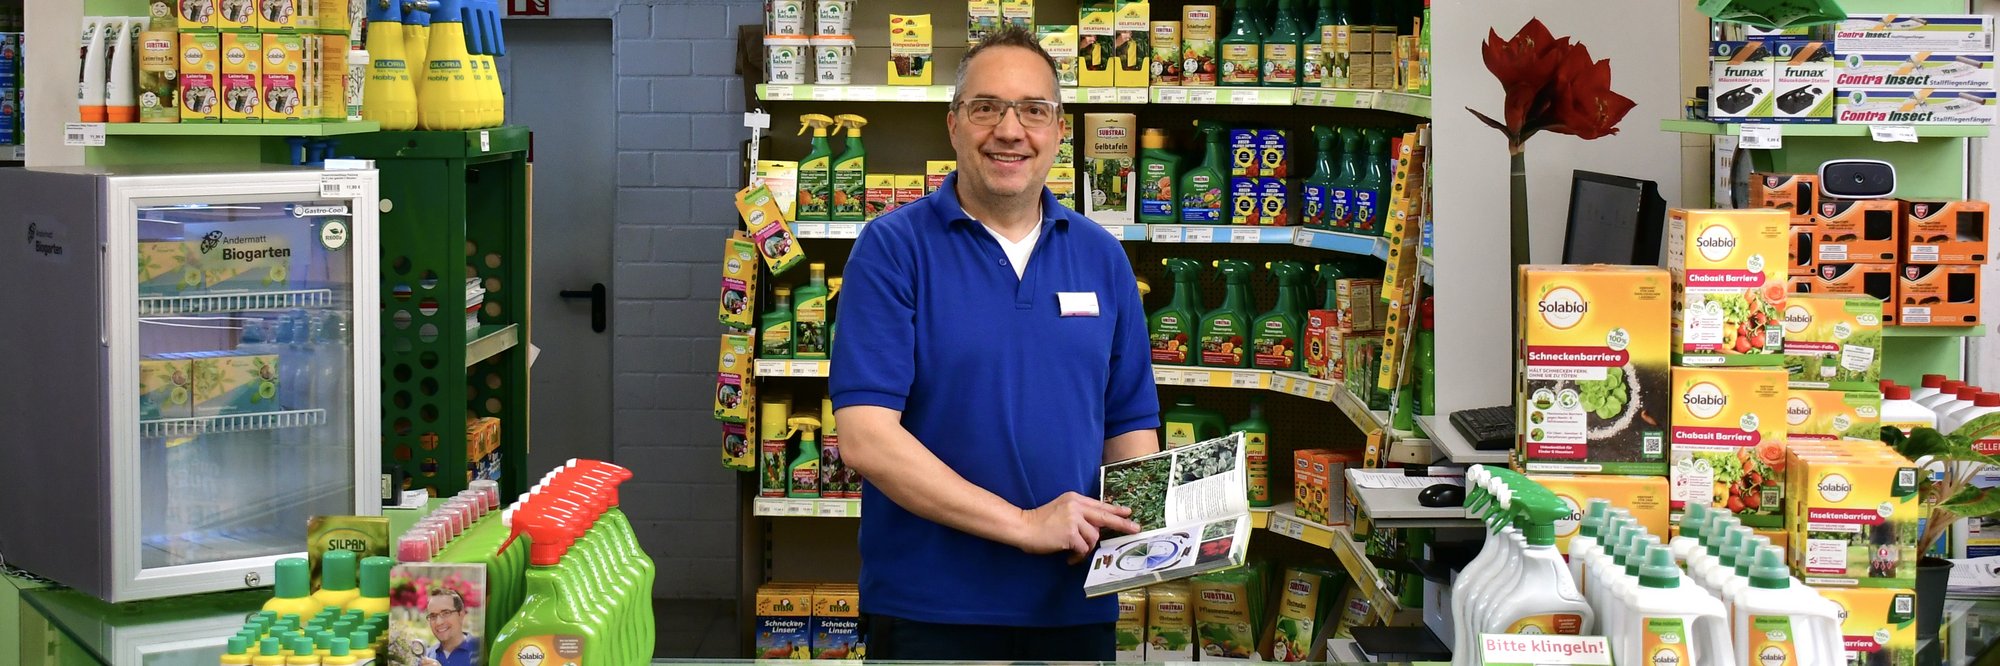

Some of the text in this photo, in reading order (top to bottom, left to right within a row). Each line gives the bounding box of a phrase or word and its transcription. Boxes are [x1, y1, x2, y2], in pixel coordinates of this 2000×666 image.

[1725, 67, 1764, 77] frunax
[1785, 67, 1824, 77] frunax
[1836, 74, 1883, 85] Contra
[1885, 74, 1930, 85] Insect
[1840, 110, 1887, 121] Contra
[1888, 111, 1934, 122] Insect
[1095, 142, 1128, 151] Gelbtafeln
[223, 236, 267, 245] Andermatt
[1696, 236, 1736, 248] Solabiol
[222, 247, 291, 262] Biogarten
[1689, 274, 1758, 282] Chabasit Barriere
[1538, 300, 1588, 313] Solabiol
[1785, 314, 1812, 323] olabiol
[1609, 335, 1628, 345] 100%
[1528, 351, 1622, 362] Schneckenbarriere
[1683, 393, 1727, 406] Solabiol
[1787, 406, 1811, 416] labiol
[1675, 431, 1752, 441] Chabasit Barriere
[1817, 482, 1852, 492] Solabiol
[1810, 511, 1877, 520] Insektenbarriere
[328, 539, 366, 553] SILPAN
[1203, 591, 1234, 601] SUBSTRAL
[1199, 605, 1243, 616] Pflaumenmaden
[764, 620, 806, 628] Schnecken-
[1486, 638, 1605, 656] Bitte klingeln!
[517, 651, 545, 660] Solabiol
[1652, 656, 1680, 664] Solabiol
[1759, 653, 1786, 661] Solabiol
